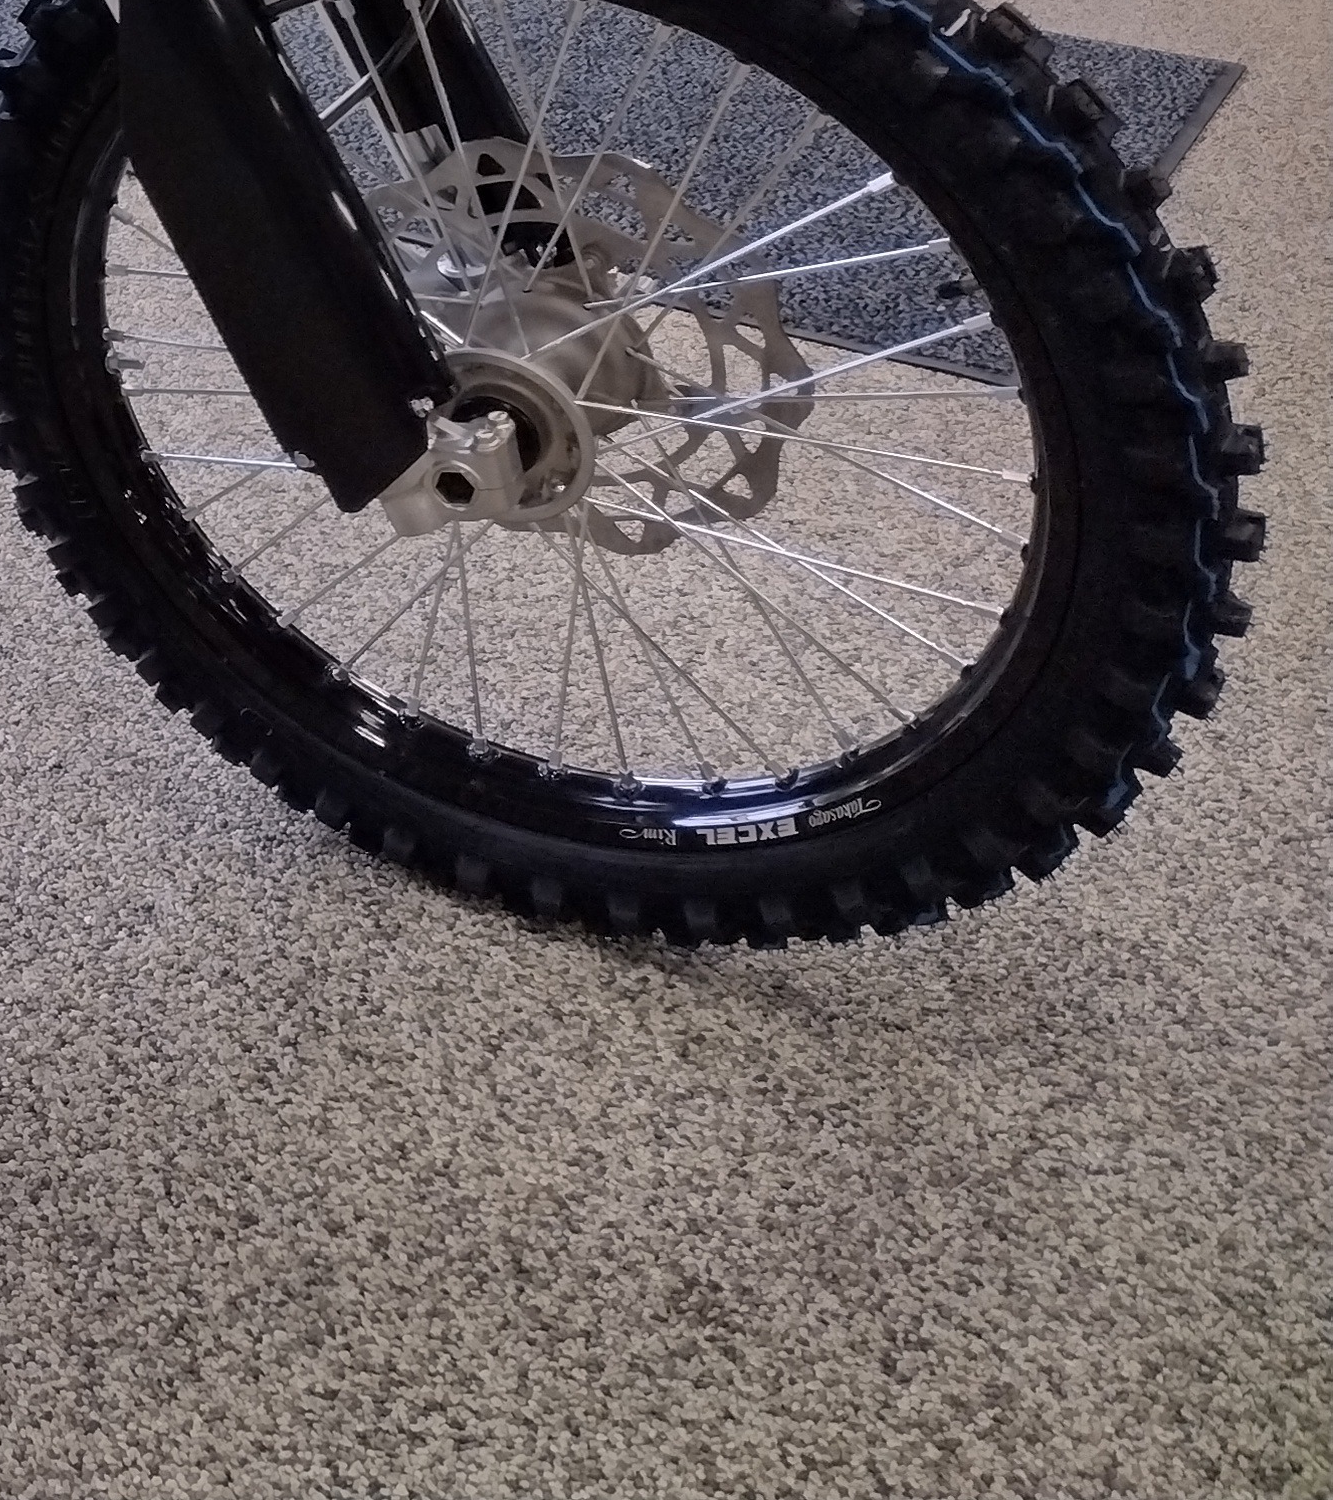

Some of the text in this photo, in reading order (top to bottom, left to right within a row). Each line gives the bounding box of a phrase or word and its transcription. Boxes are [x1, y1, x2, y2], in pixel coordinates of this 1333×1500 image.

[633, 797, 874, 846] Takasago EXCEL Rim
